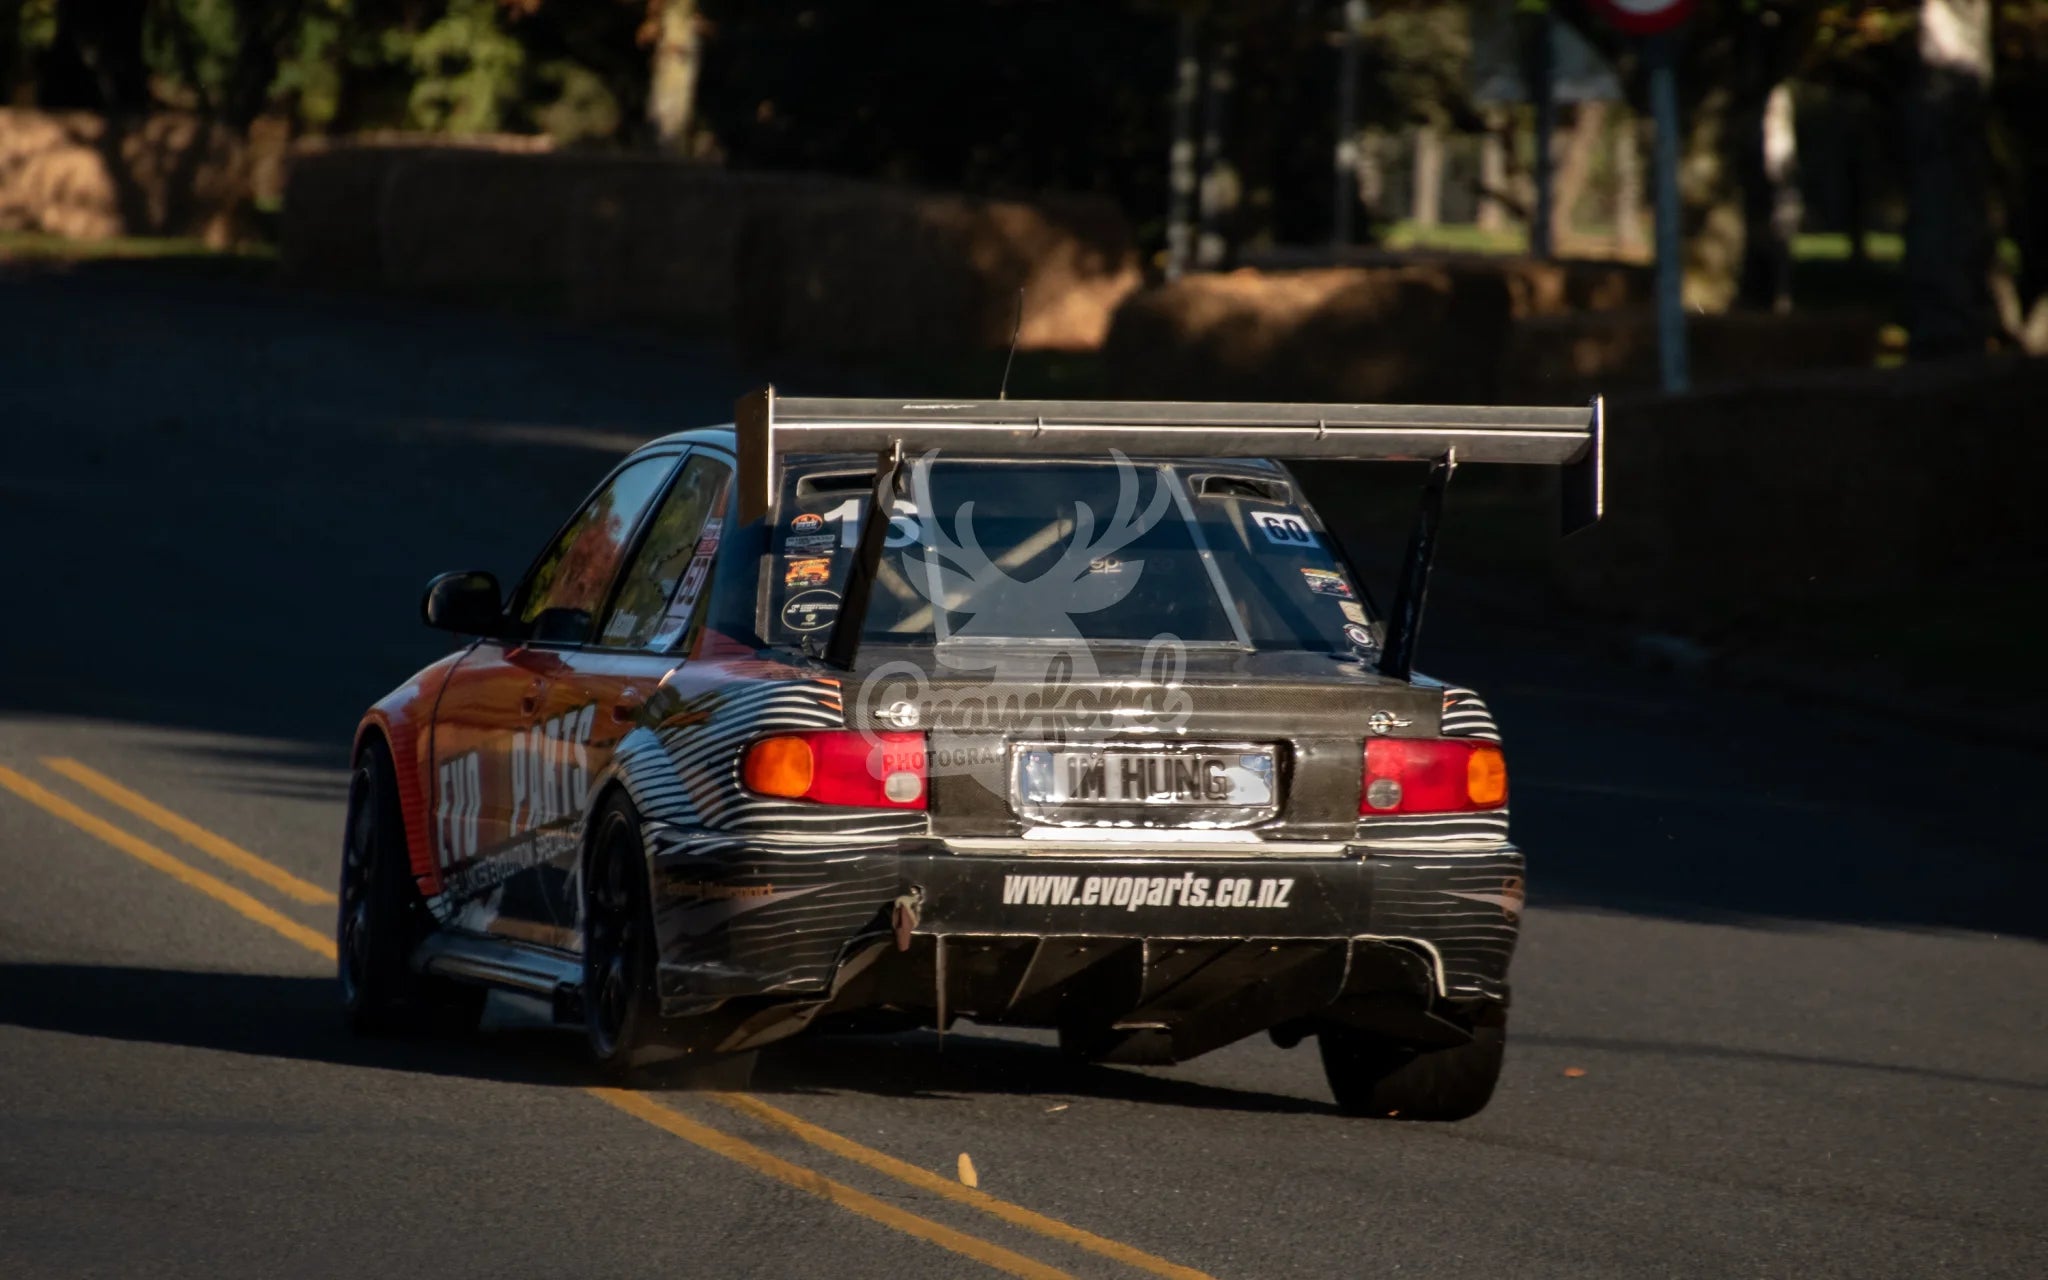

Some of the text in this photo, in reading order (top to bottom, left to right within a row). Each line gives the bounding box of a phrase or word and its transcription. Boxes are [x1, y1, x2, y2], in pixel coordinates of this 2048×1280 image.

[1262, 516, 1310, 543] 60
[510, 703, 596, 838] PARTS
[1120, 758, 1230, 801] HUNG
[1002, 871, 1295, 912] www.evoparts.co.nz
